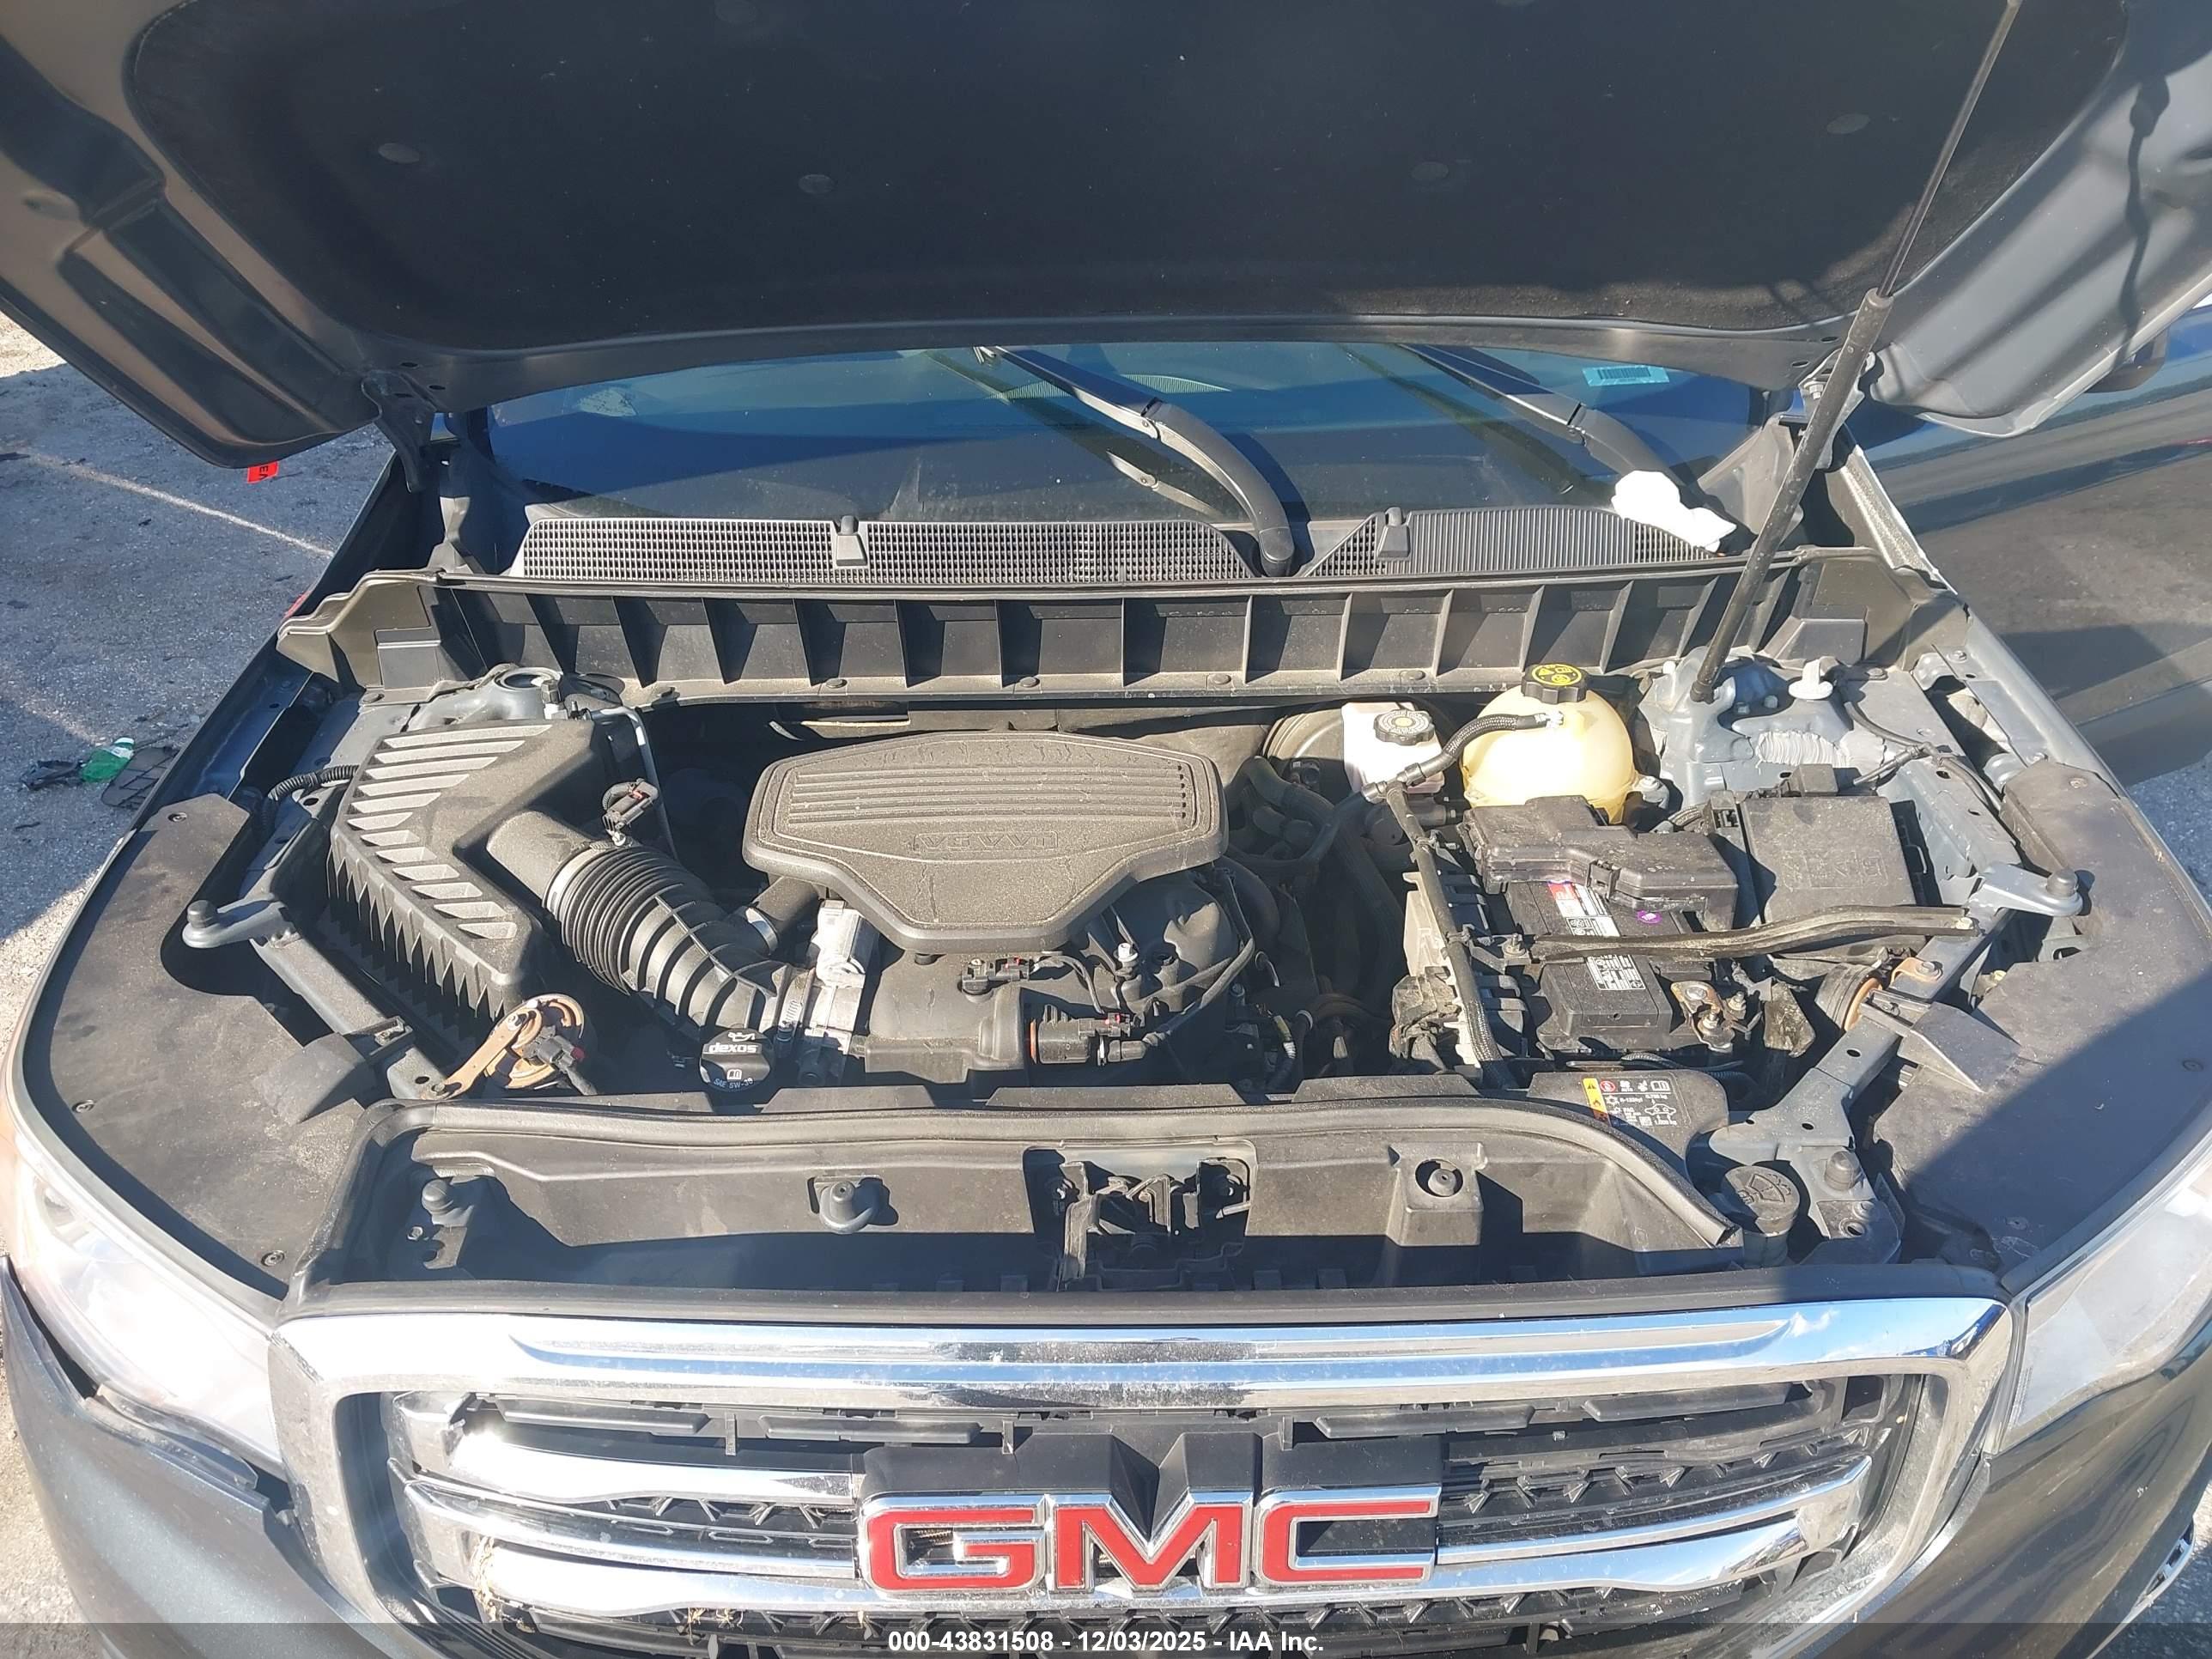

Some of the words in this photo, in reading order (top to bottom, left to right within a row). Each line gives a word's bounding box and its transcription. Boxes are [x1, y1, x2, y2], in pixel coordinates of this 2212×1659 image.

[708, 1042, 758, 1053] dexos
[714, 1078, 727, 1088] SAE
[861, 1491, 1439, 1592] GMC
